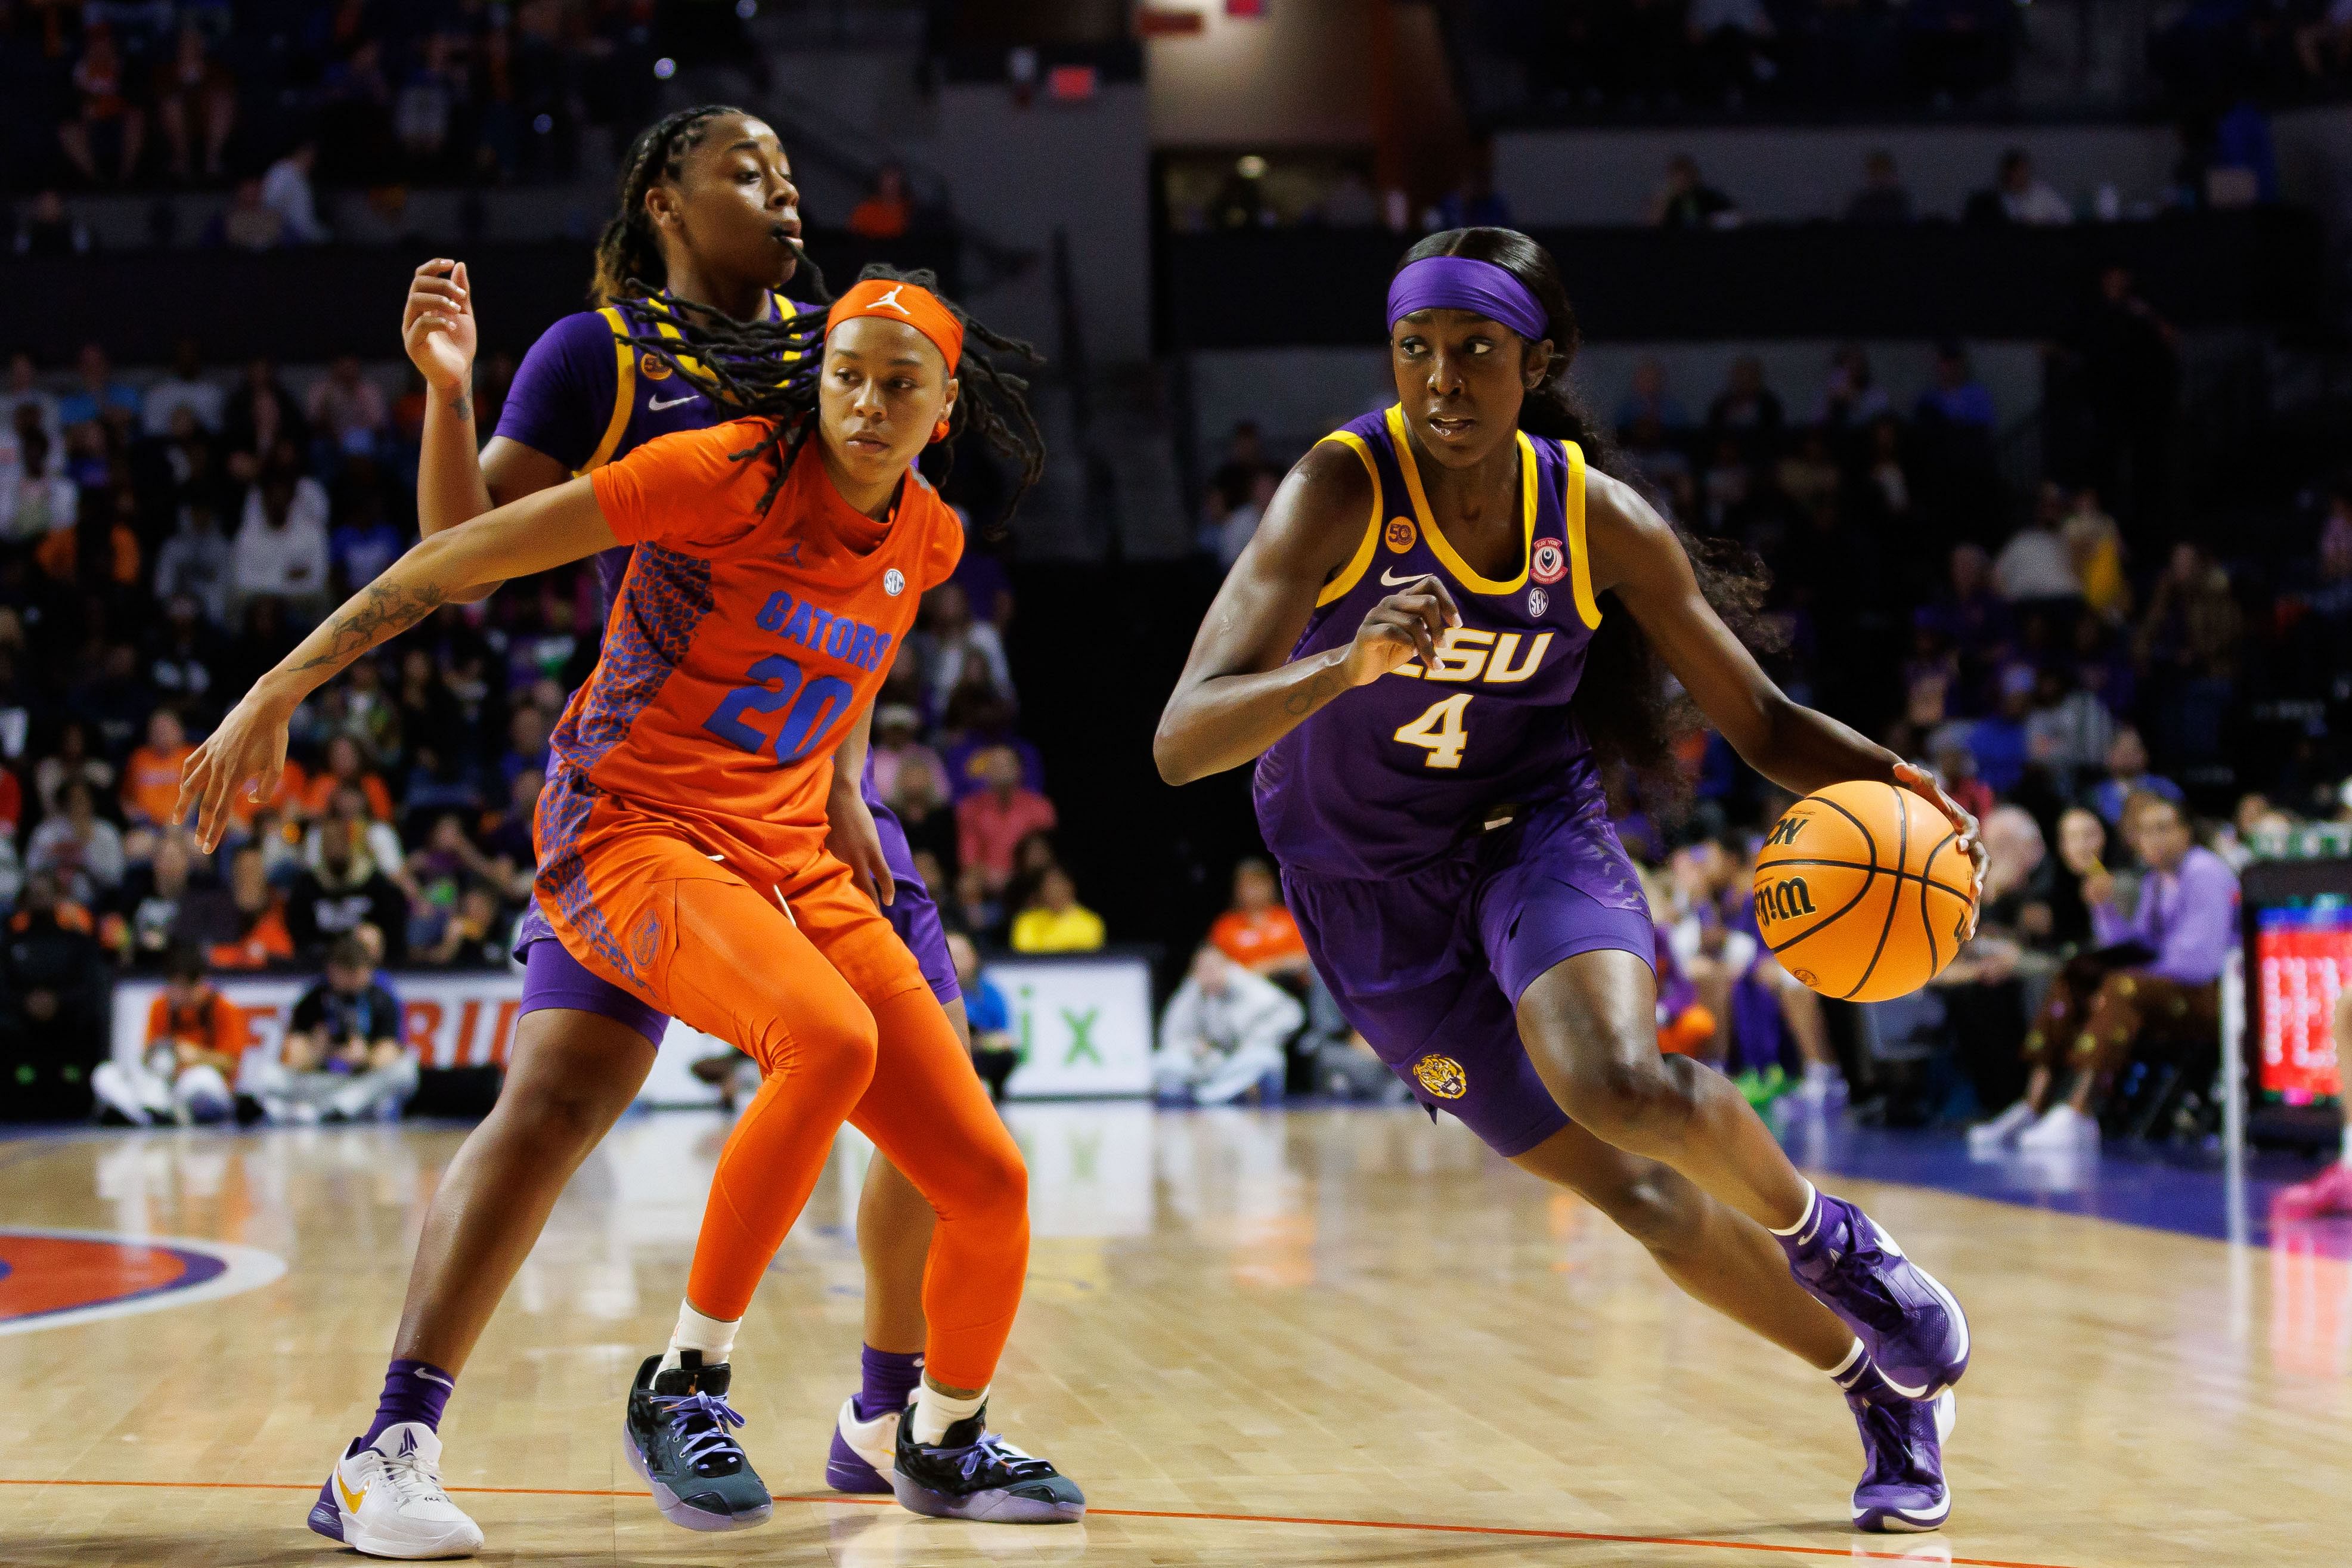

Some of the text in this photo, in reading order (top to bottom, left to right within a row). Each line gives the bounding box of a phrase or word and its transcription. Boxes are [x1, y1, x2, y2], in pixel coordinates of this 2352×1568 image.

[1388, 523, 1412, 546] 50
[1530, 589, 1547, 615] SEC
[755, 590, 893, 673] GATORS
[1390, 627, 1555, 683] SU
[701, 653, 854, 765] 20
[1393, 693, 1474, 769] 4
[1755, 876, 1817, 926] Wil
